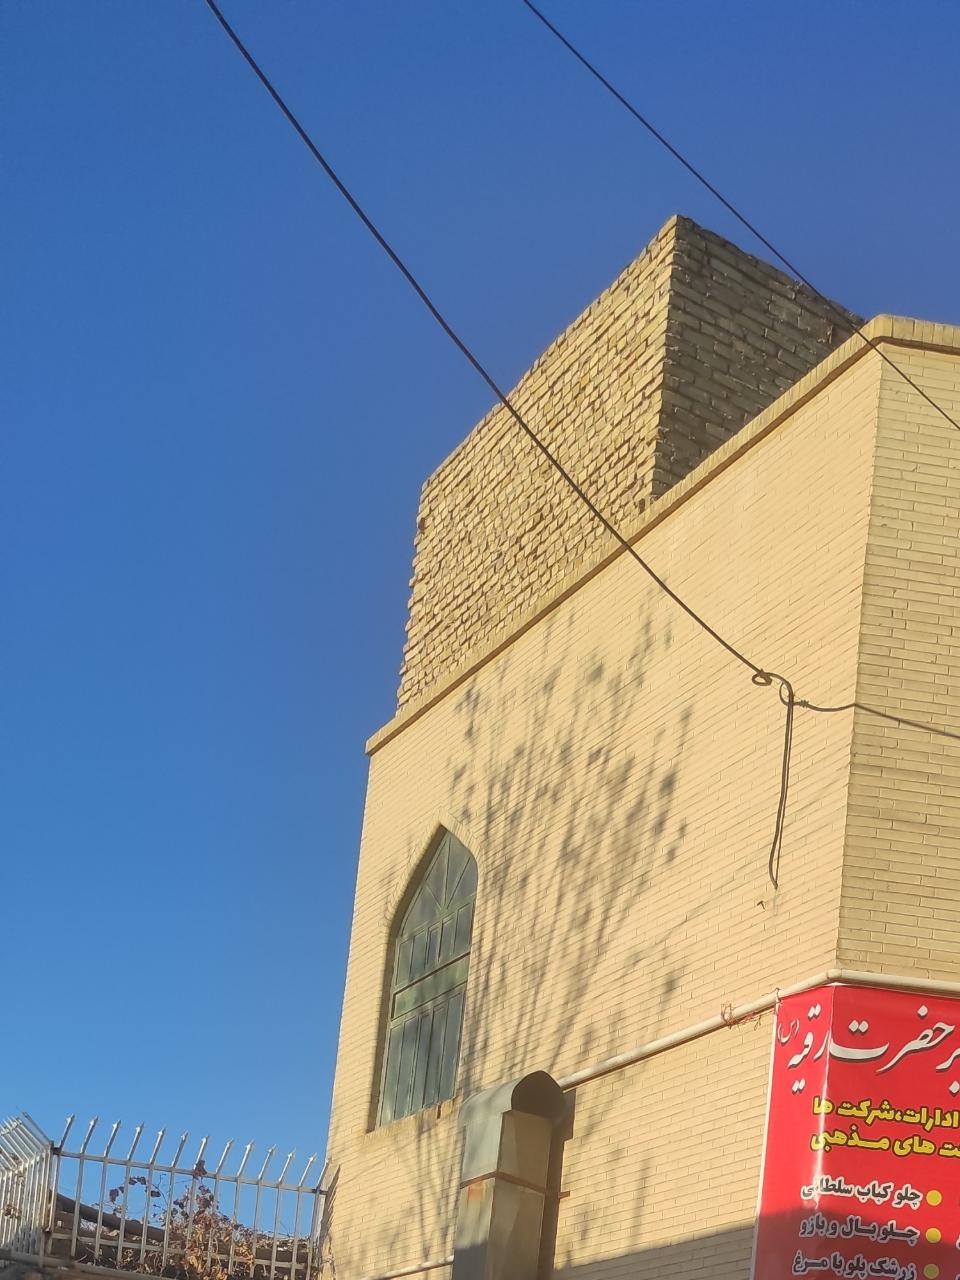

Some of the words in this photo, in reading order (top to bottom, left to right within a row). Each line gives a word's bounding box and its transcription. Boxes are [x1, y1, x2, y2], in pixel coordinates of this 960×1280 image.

[787, 1003, 831, 1095] رقیه
[829, 1004, 956, 1074] حضرت
[813, 1097, 834, 1115] ها
[810, 1123, 890, 1151] مذهبی
[894, 1134, 936, 1156] های
[801, 1175, 854, 1200] سلطای
[856, 1180, 893, 1204] کباب
[893, 1184, 923, 1209] چلو
[799, 1212, 827, 1238] بازو
[827, 1220, 839, 1238] و
[841, 1215, 878, 1241] بال
[878, 1220, 920, 1246] چلو
[792, 1250, 830, 1275] مرغ
[831, 1251, 844, 1275] با
[844, 1254, 868, 1280] پلو
